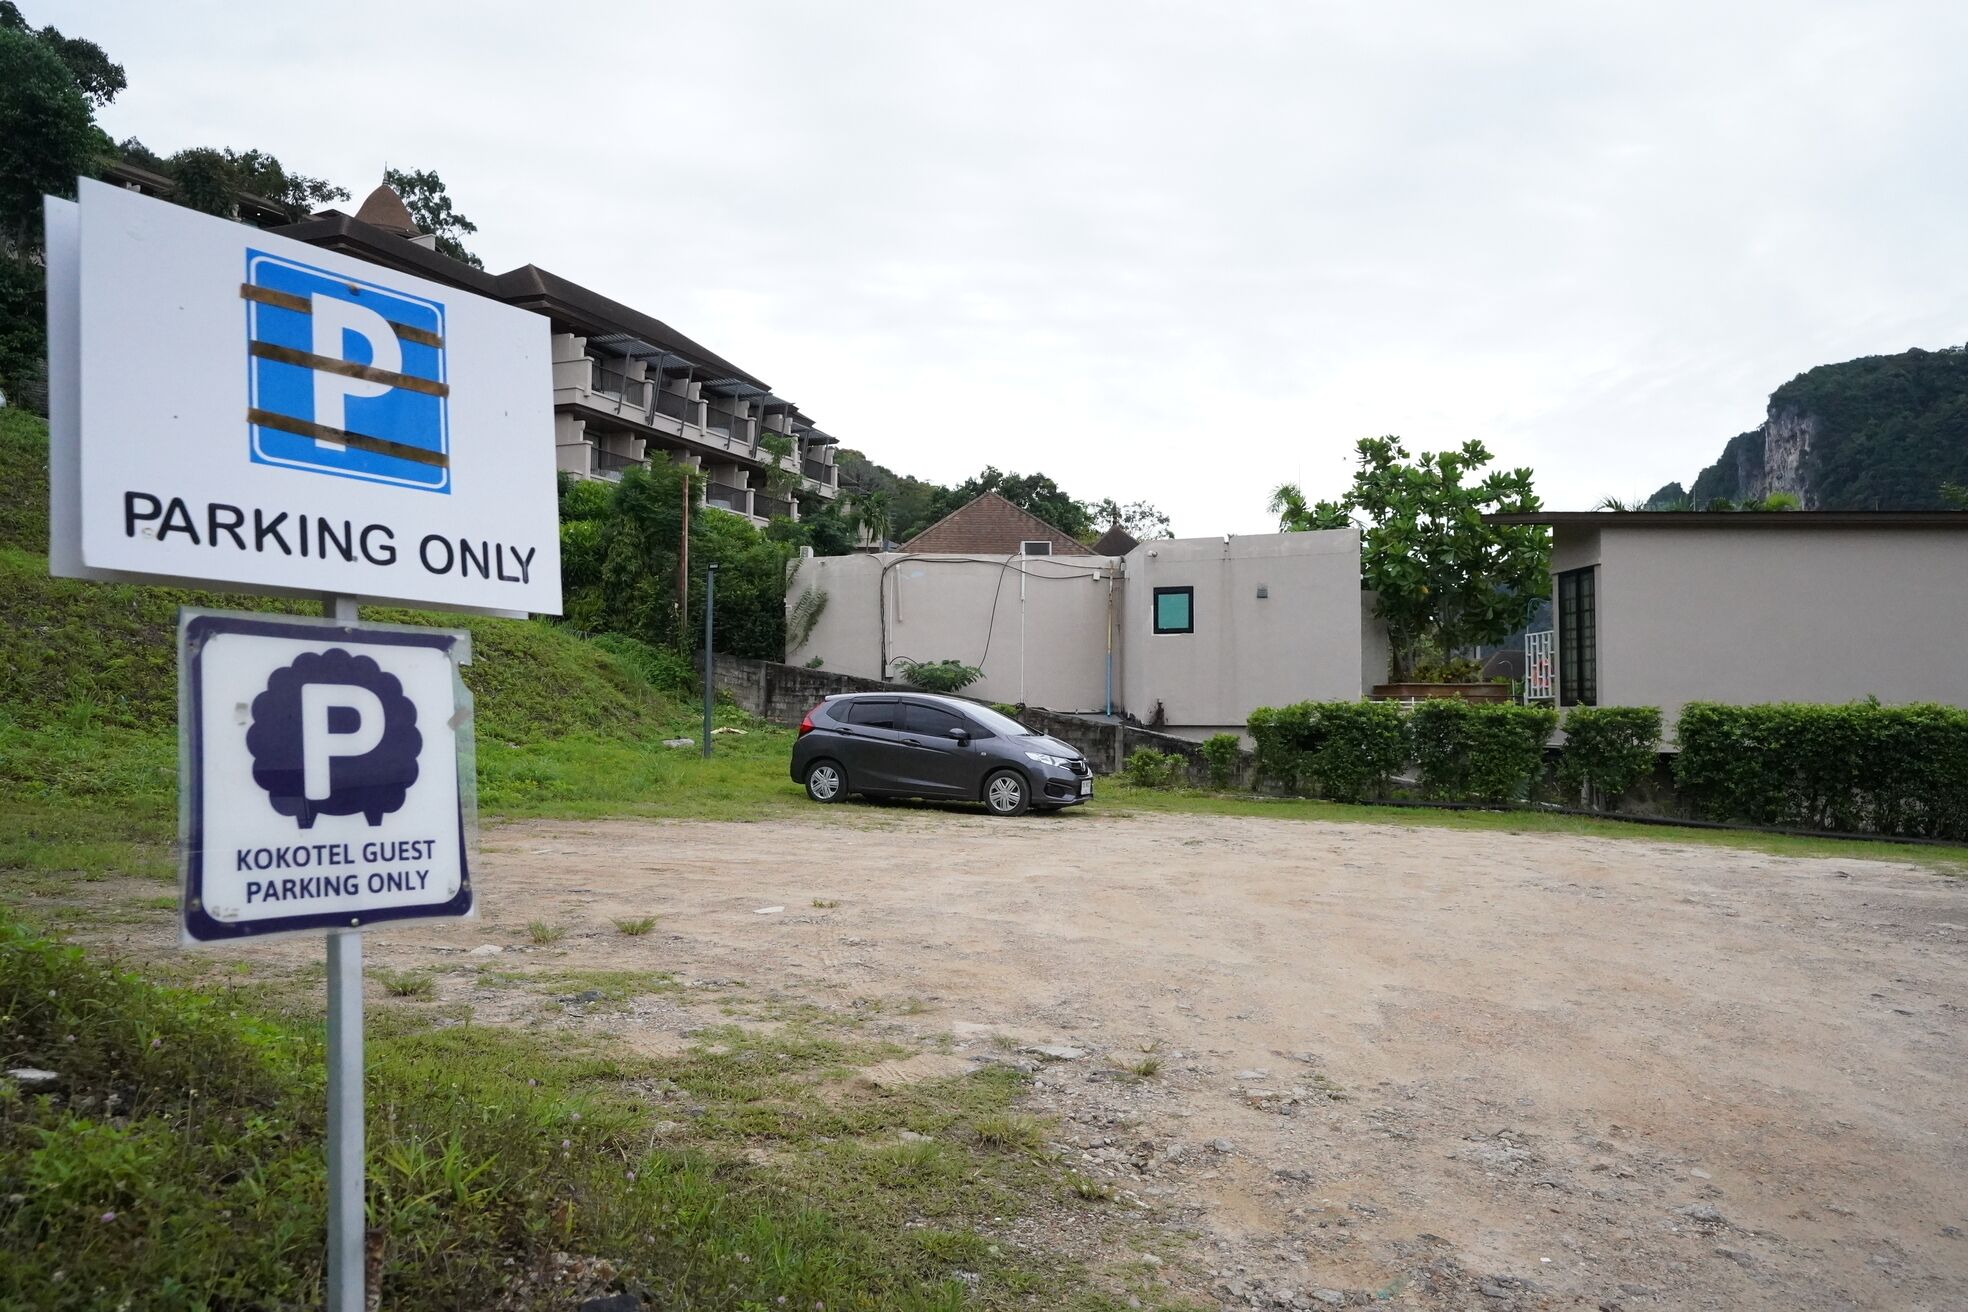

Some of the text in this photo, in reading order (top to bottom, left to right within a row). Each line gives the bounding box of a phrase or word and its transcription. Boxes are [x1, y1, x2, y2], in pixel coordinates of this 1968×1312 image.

[312, 292, 401, 452] P
[124, 491, 536, 584] PARKING ONLY
[301, 683, 385, 801] P
[237, 840, 436, 871] KOKOTEL GUEST
[246, 870, 429, 903] PARKING ONLY
